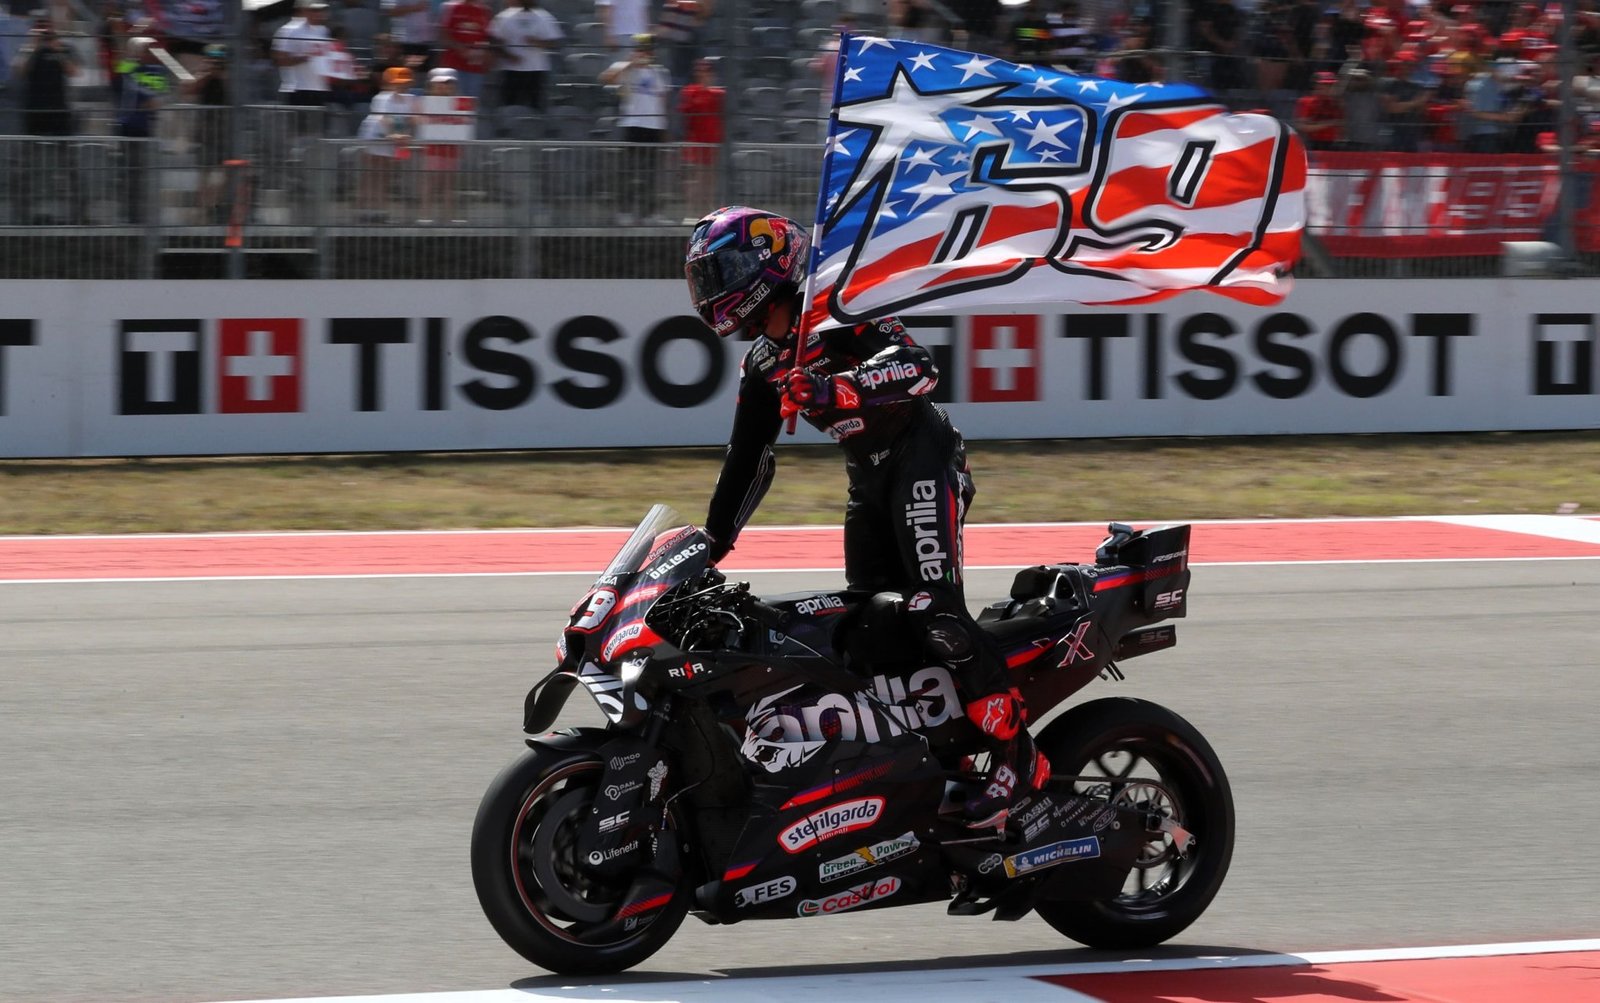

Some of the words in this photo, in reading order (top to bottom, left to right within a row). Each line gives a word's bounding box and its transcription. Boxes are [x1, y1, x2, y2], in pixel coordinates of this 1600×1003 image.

[328, 314, 756, 411] TISSO
[1061, 312, 1477, 400] TISSOT
[859, 361, 919, 390] aprilia
[905, 479, 947, 582] aprilia
[795, 593, 845, 616] aprilia
[1156, 589, 1184, 605] SC
[599, 810, 630, 830] SC
[787, 800, 878, 845] sterilgarda
[604, 840, 639, 860] Lifenet.it
[1033, 844, 1092, 864] MICHELIN
[823, 858, 857, 875] Green
[822, 878, 896, 913] Castrol
